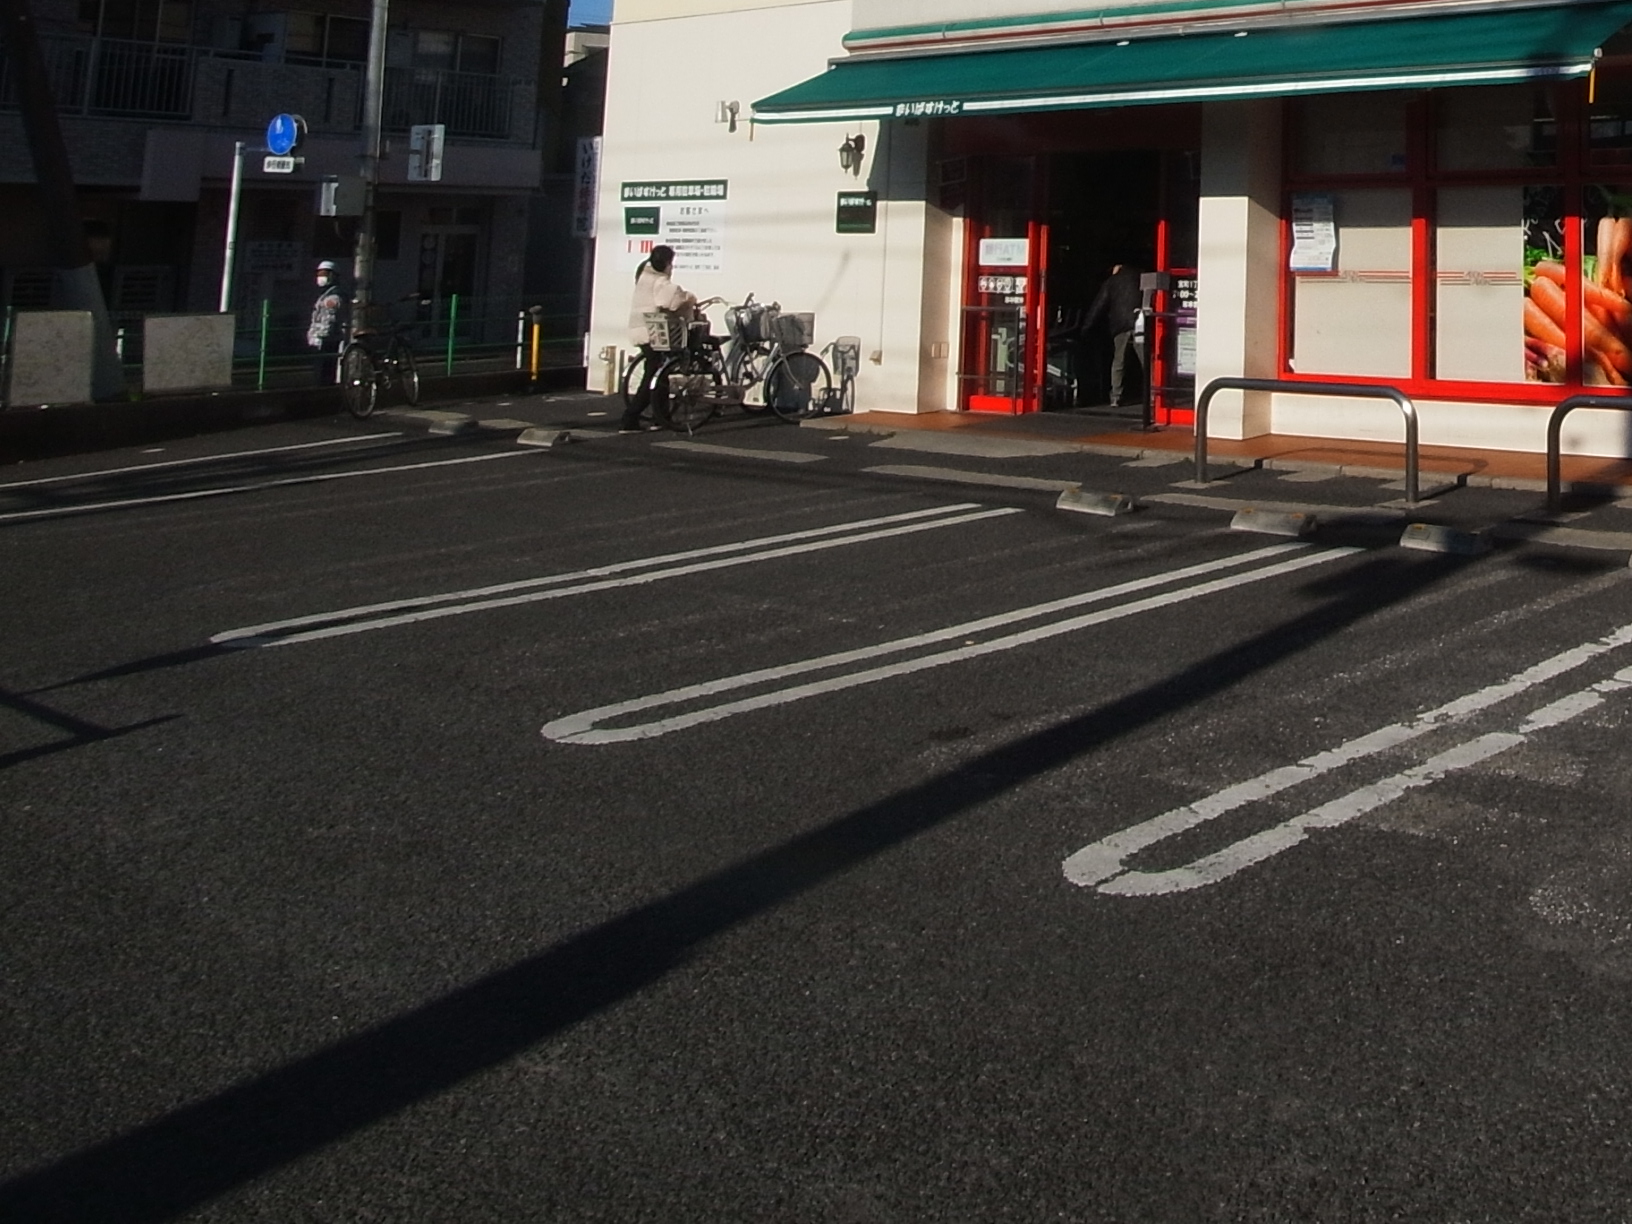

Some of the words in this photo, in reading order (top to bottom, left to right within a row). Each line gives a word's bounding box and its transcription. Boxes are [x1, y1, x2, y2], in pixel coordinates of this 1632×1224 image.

[895, 100, 960, 117] まいばすけっと
[623, 185, 667, 198] まいばすけっと
